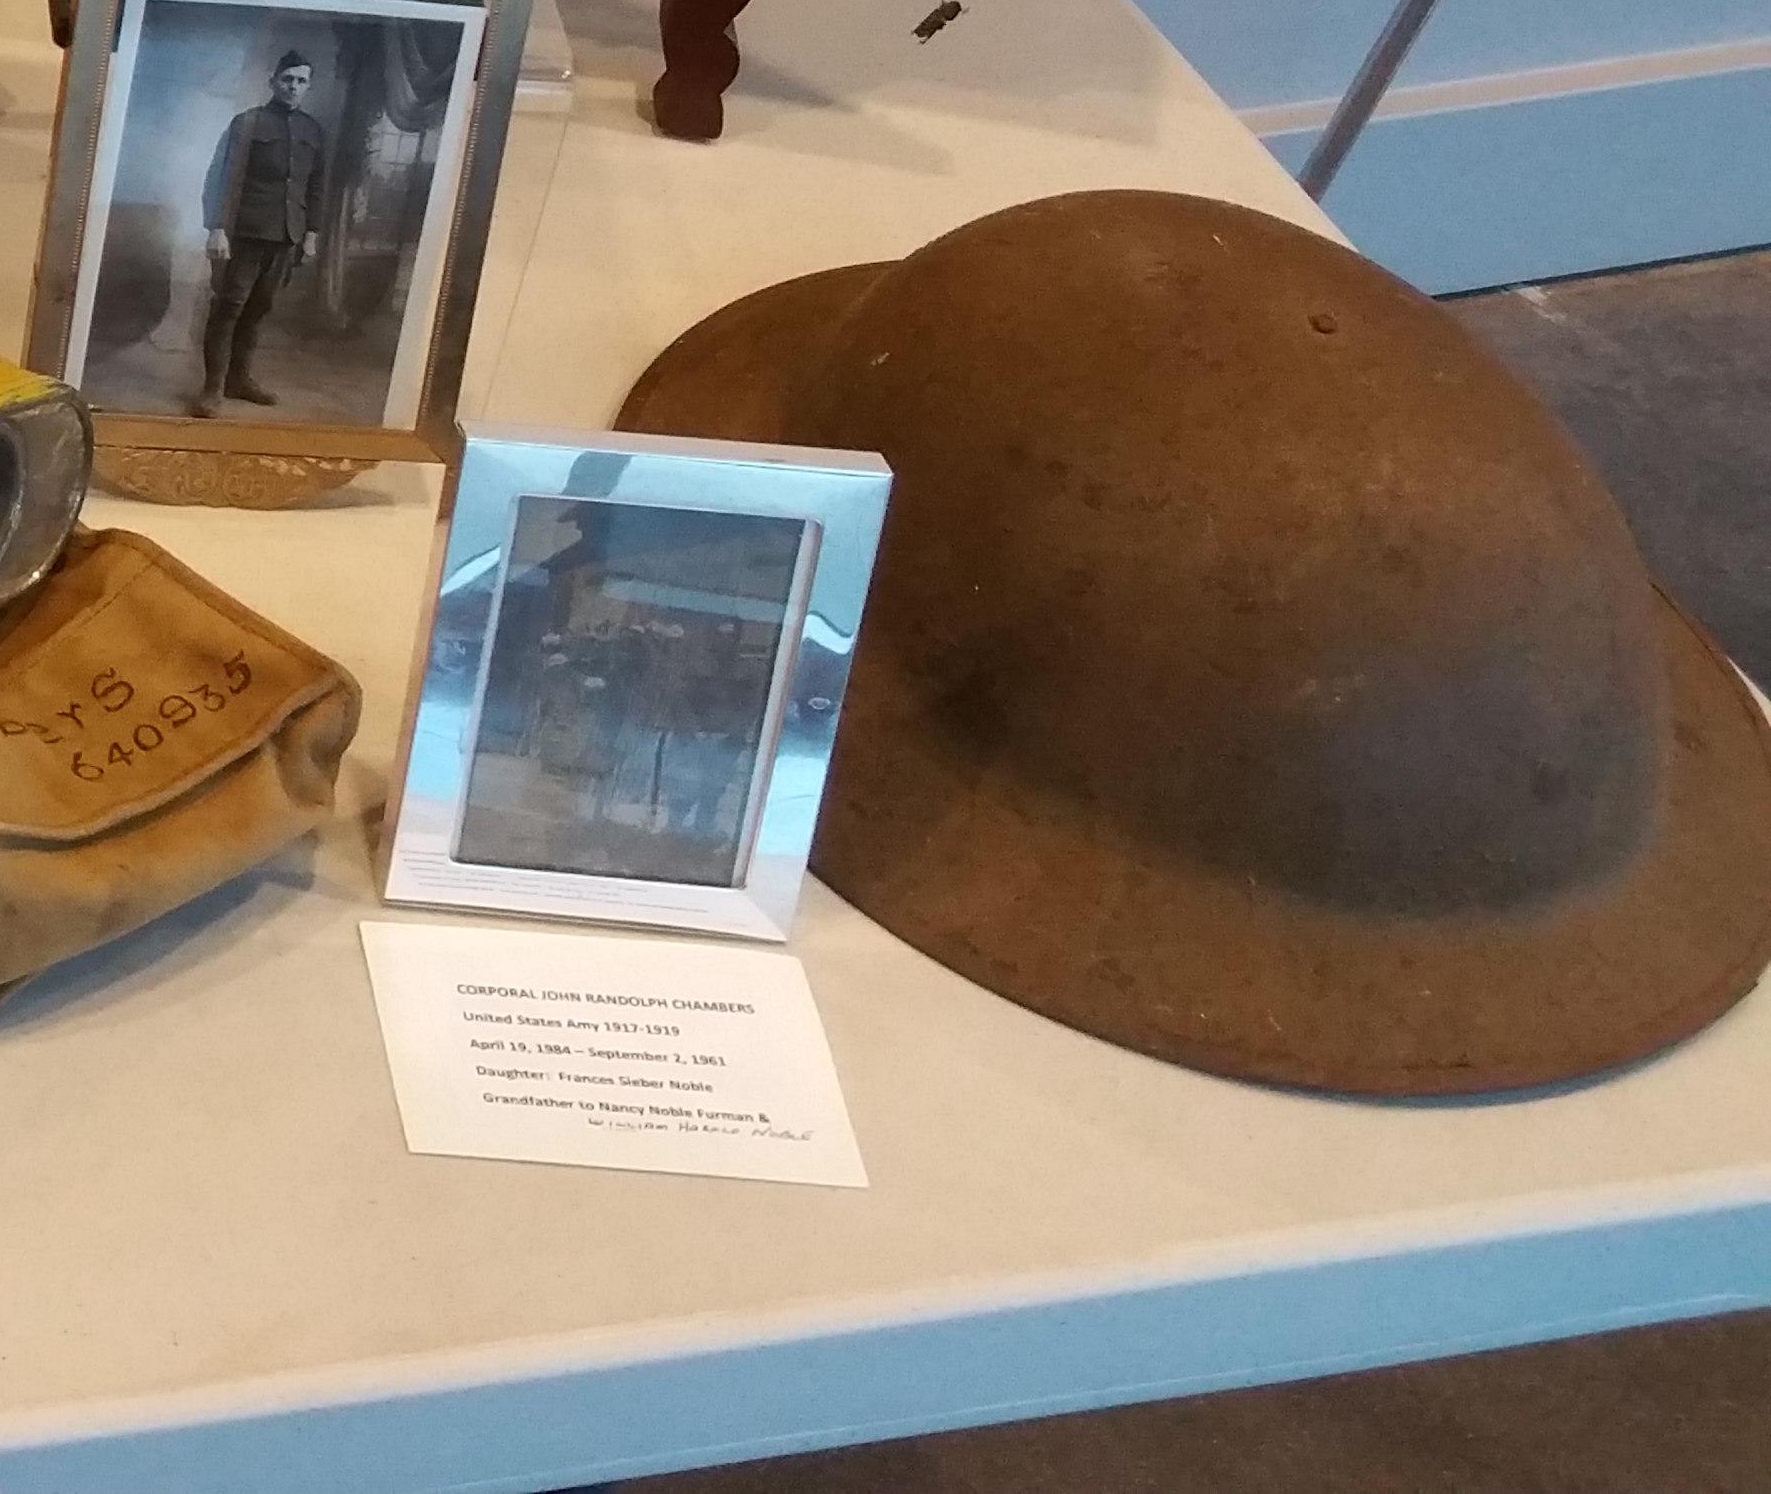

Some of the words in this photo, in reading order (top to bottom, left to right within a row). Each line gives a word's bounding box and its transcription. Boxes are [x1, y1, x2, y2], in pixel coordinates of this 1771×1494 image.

[70, 649, 253, 782] 640935
[456, 983, 537, 1000] CORPORAL
[541, 989, 581, 1003] JOHN
[585, 992, 668, 1009] RANDOLPH
[671, 998, 755, 1015] CHAMBERS
[462, 1011, 512, 1025] United
[516, 1014, 561, 1028] States
[605, 1021, 679, 1037] 1917-1919
[470, 1039, 505, 1053] April
[509, 1041, 532, 1054] 19,
[536, 1043, 570, 1056] 1984
[588, 1047, 667, 1064] September
[672, 1052, 687, 1064] 2,
[690, 1053, 726, 1066] 1961
[476, 1066, 548, 1083] Daughter:
[558, 1071, 615, 1085] Frances
[618, 1075, 663, 1089] Sieber
[669, 1079, 713, 1092] Noble
[482, 1092, 573, 1110] Grandfather
[578, 1099, 594, 1111] to
[598, 1100, 645, 1117] Nancy
[648, 1104, 692, 1118] Noble
[696, 1108, 752, 1122] Furman
[759, 1112, 770, 1124] &
